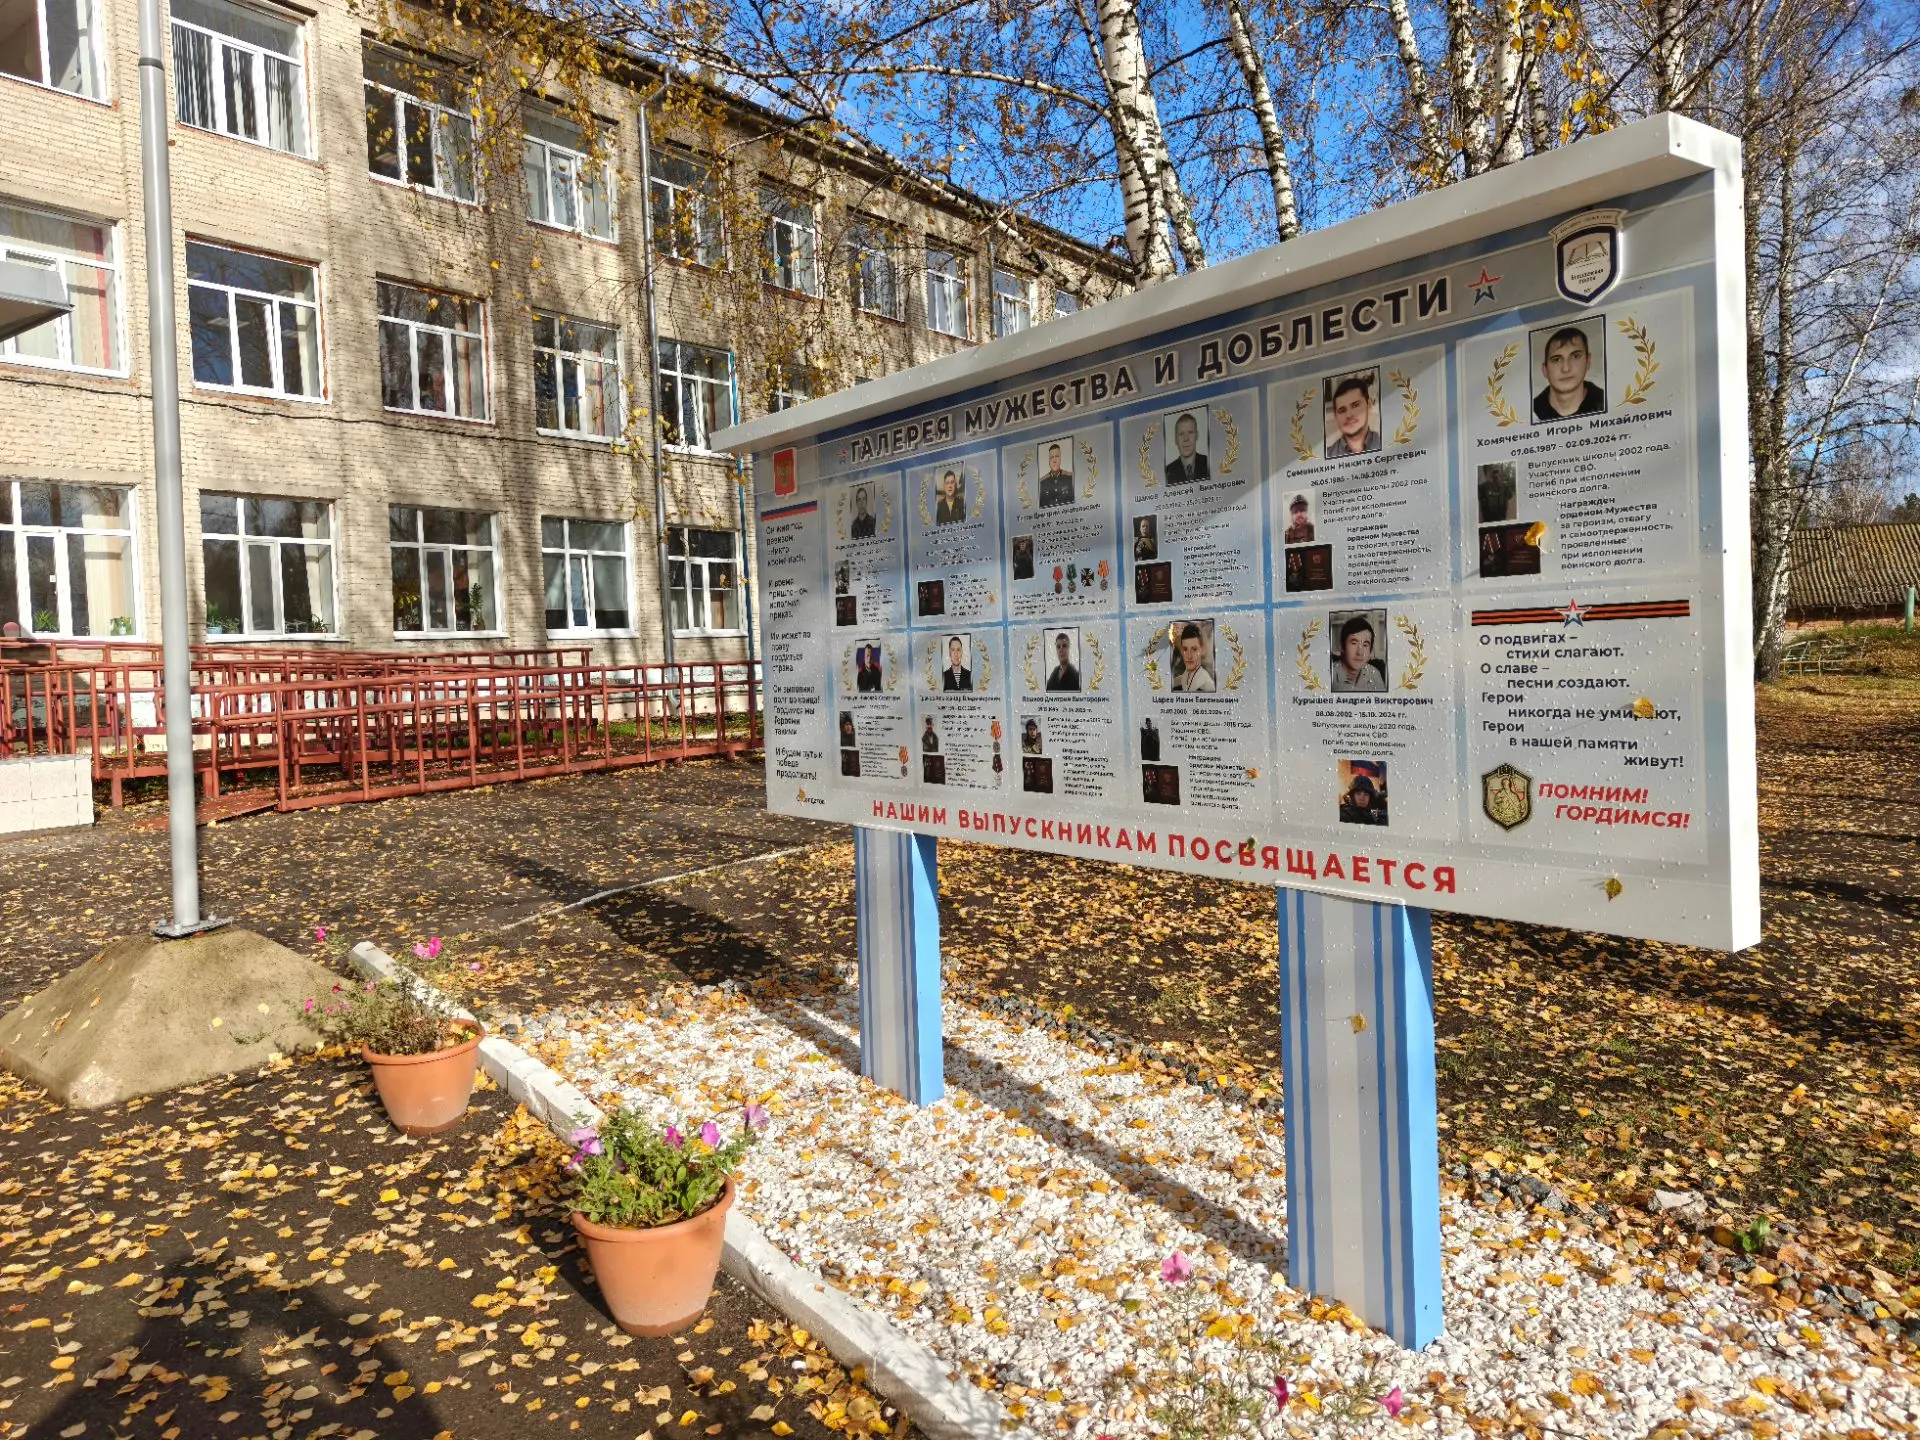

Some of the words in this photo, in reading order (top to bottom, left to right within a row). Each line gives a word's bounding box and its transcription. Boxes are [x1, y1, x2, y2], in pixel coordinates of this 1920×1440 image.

[851, 414, 951, 464] ГАЛЕРЕЯ
[965, 369, 1133, 433] МУЖЕСТВА
[1154, 353, 1177, 385] И
[1197, 277, 1450, 383] ДОБЛЕСТИ
[1476, 430, 1540, 448] Хомяченко
[1546, 424, 1583, 436] Игорь
[1590, 409, 1672, 430] Михайлович
[1510, 443, 1556, 457] 07.06.1987
[1566, 434, 1616, 448] 02.09.2024
[1338, 458, 1372, 470] Никита
[1374, 450, 1426, 464] Сергеевич
[1528, 457, 1580, 470] Выпускник
[1582, 451, 1617, 462] школы
[1619, 446, 1642, 456] 2002
[1645, 442, 1672, 454] года.
[1528, 466, 1572, 479] Участник
[1574, 463, 1597, 474] СВО.
[1529, 477, 1557, 490] Погиб
[1559, 477, 1578, 488] при
[1580, 468, 1641, 483] исполнении
[1163, 486, 1194, 498] Алексей
[1200, 479, 1246, 492] Викторович
[1322, 488, 1362, 498] Выпускник
[1364, 484, 1390, 493] школы
[1410, 478, 1430, 487] года.
[1528, 486, 1578, 499] воинского
[1579, 483, 1610, 494] долга.
[1322, 498, 1356, 507] Участник
[1356, 494, 1374, 502] СВО.
[1560, 497, 1616, 510] Награжден
[1324, 507, 1344, 516] Погиб
[1362, 500, 1407, 512] исполнении
[1560, 508, 1603, 520] орденом
[1606, 503, 1658, 516] Мужества
[1324, 514, 1360, 524] воинского
[1560, 521, 1572, 530] за
[1573, 517, 1616, 529] героизм,
[1618, 514, 1652, 526] отвагу
[1347, 534, 1380, 542] орденом
[1382, 528, 1420, 538] Мужества
[1391, 538, 1416, 547] отвагу
[1561, 538, 1628, 550] проявленные
[1561, 550, 1580, 561] при
[1582, 546, 1643, 559] исполнении
[1561, 558, 1612, 570] воинского
[1614, 556, 1646, 568] долга.
[1348, 570, 1362, 578] при
[1364, 566, 1408, 576] исполнении
[1348, 578, 1386, 586] воинского
[1480, 634, 1491, 646] О
[1494, 632, 1566, 647] подвигах
[1506, 648, 1550, 660] стихи
[1554, 647, 1624, 659] слагают.
[1480, 662, 1492, 674] О
[1496, 664, 1538, 674] славе
[1507, 678, 1554, 689] песни
[1558, 677, 1630, 690] создают.
[1176, 696, 1194, 704] Иван
[1196, 696, 1239, 704] Евгеньевич
[1336, 696, 1372, 706] Андрей
[1374, 697, 1433, 706] Викторович
[1482, 692, 1524, 706] Герои
[1508, 707, 1571, 720] никогда
[1576, 709, 1595, 719] не
[1600, 708, 1681, 722] умиют,
[1312, 721, 1351, 730] Выпускник
[1353, 722, 1378, 730] школы
[1482, 720, 1524, 734] Герои
[1360, 740, 1406, 749] исполнении
[1510, 738, 1517, 746] в
[1522, 736, 1572, 748] нашей
[1578, 738, 1638, 750] памяти
[1333, 748, 1370, 756] воинского
[1624, 755, 1684, 769] живут!
[1538, 782, 1650, 804] ПОМНИМ!
[1555, 804, 1691, 828] ГОРДИМСЯ!
[872, 799, 948, 827] НАШИМ
[958, 809, 1158, 854] ВЫПУСКНИКАМ
[1168, 833, 1458, 895] ПОСВЯЩАЕТСЯ
